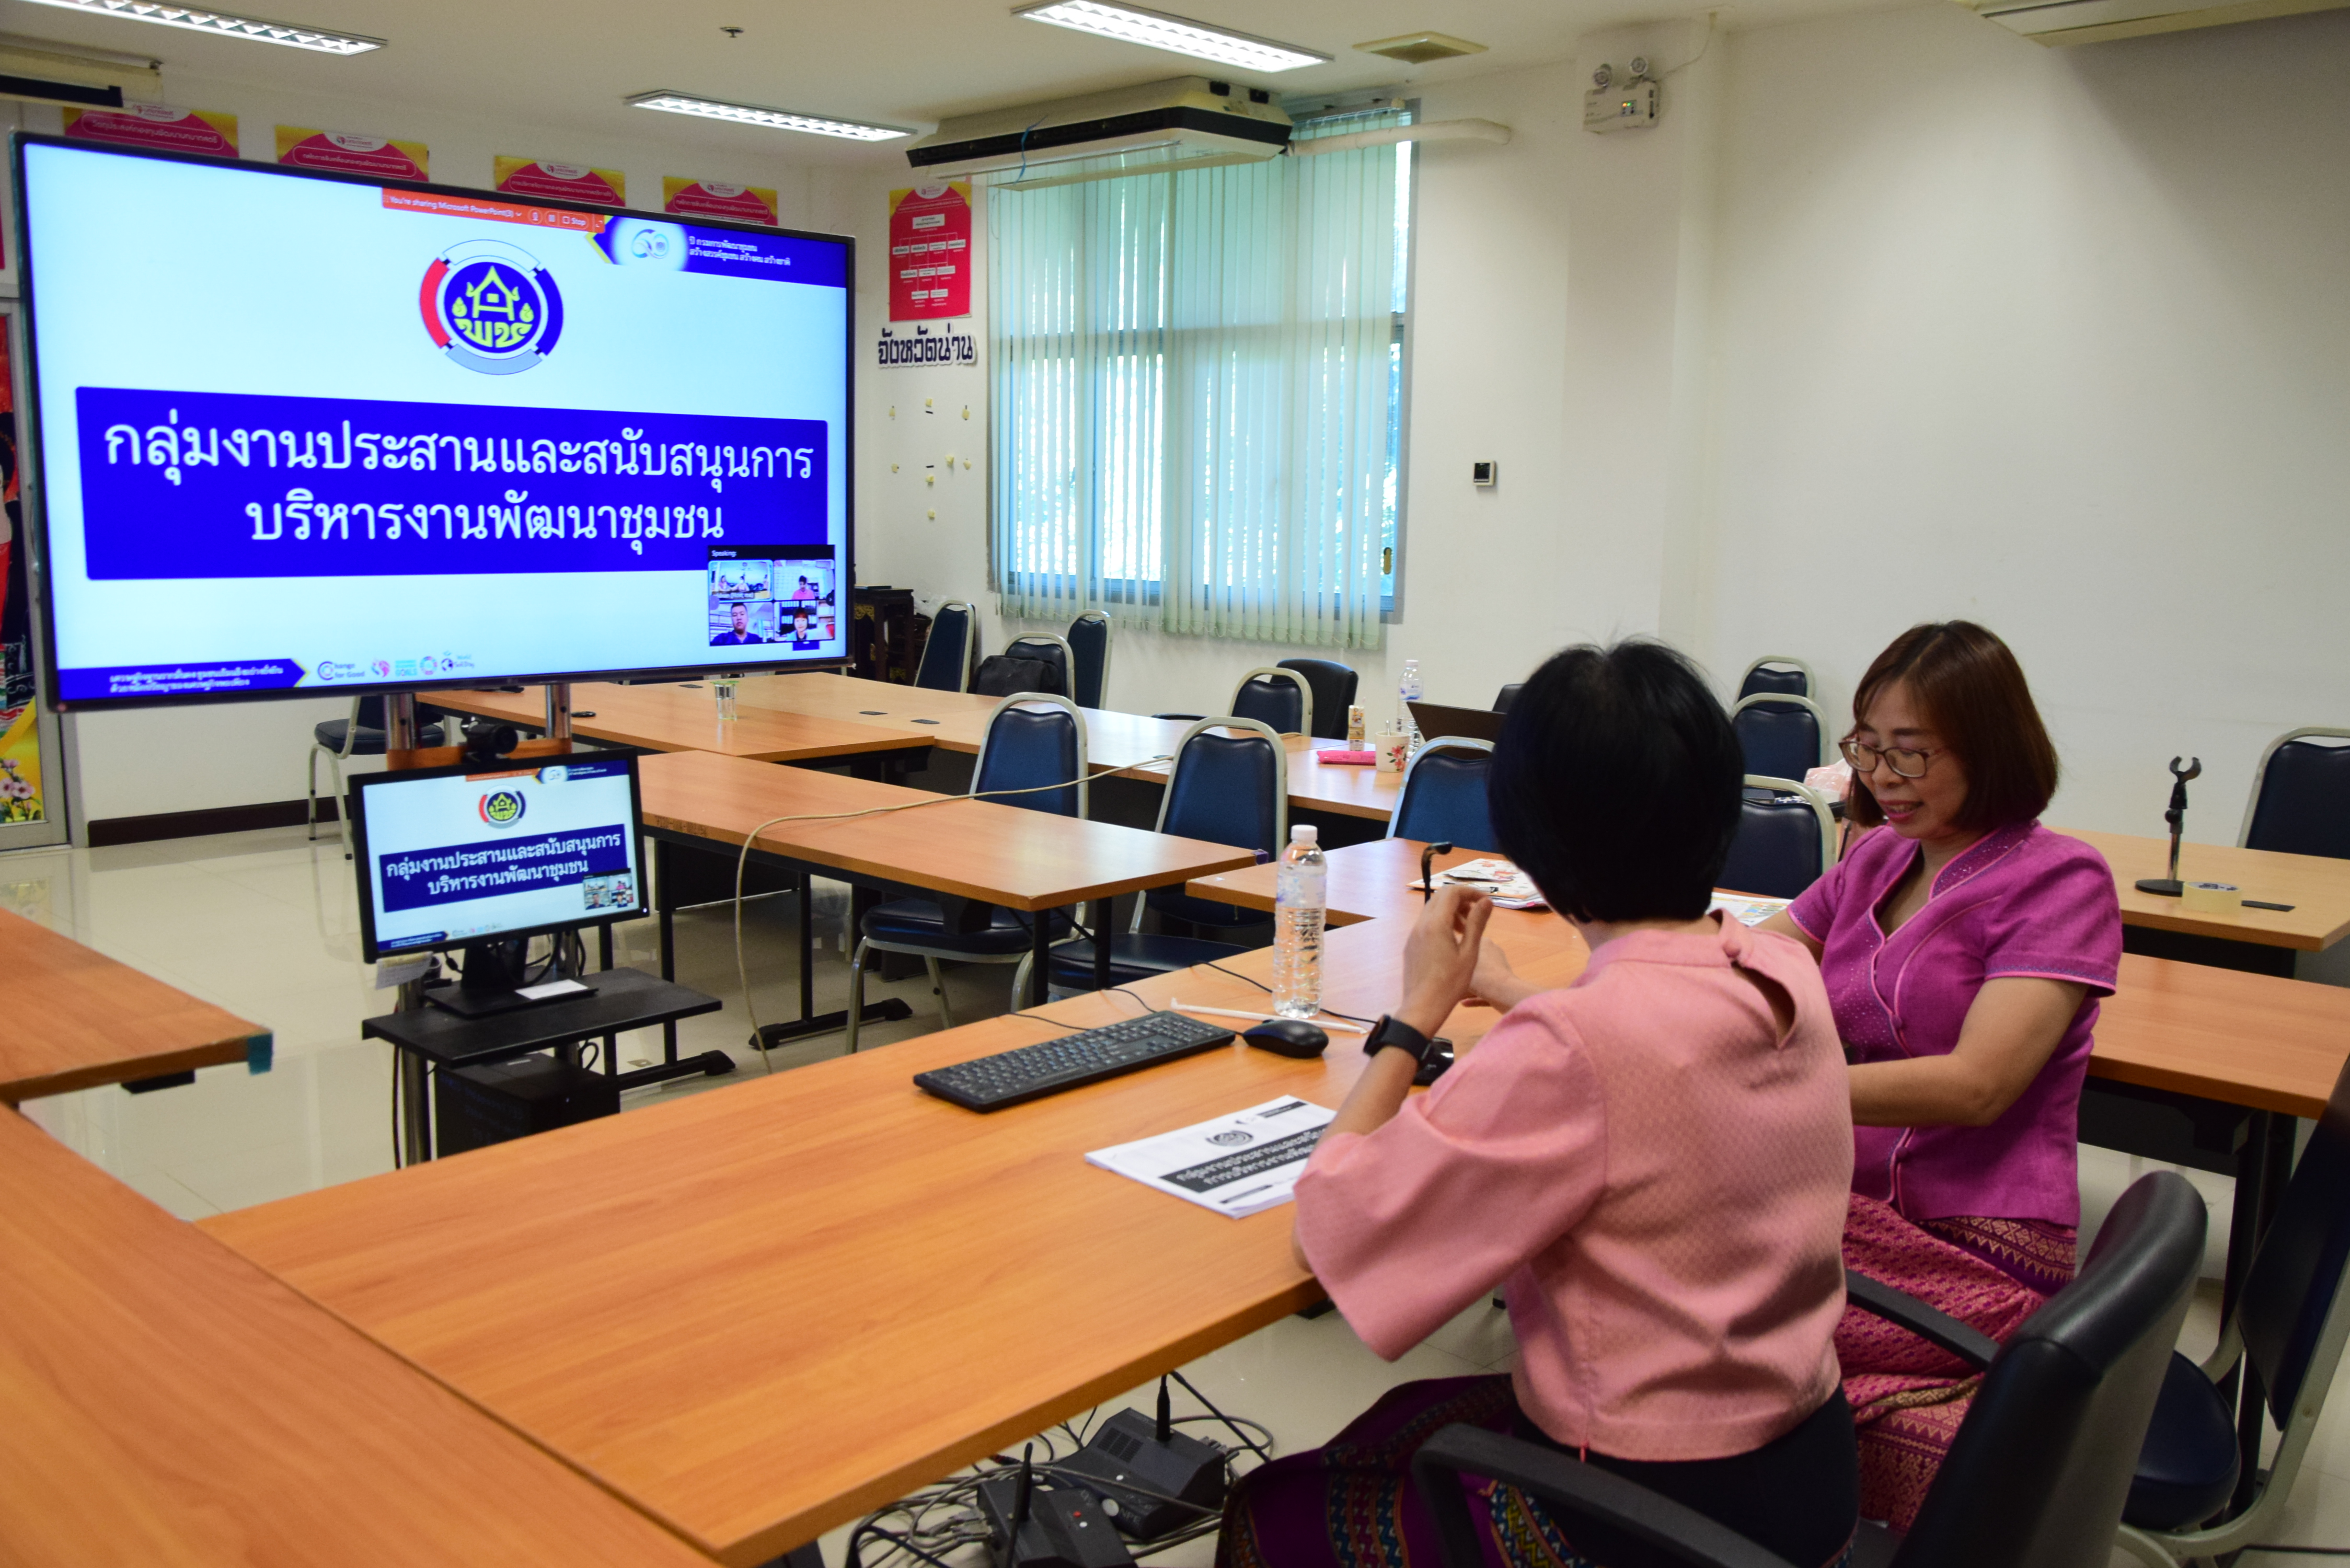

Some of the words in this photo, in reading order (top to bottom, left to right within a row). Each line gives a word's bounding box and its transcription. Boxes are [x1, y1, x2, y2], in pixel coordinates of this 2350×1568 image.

[390, 196, 411, 205] You're
[412, 199, 437, 209] sharing
[438, 201, 469, 211] Microsoft
[571, 217, 586, 226] Stop
[878, 322, 973, 364] จังหวัดน่าน
[105, 408, 814, 493] กลุ่มงานประสานและสนับสนุนการ
[245, 487, 724, 556] บริหารงานพัฒนาชุมชน
[386, 833, 621, 881] กลุ่มงานประสานและสนับสนุนการ
[427, 860, 589, 895] บริหารงานพัฒนาชุมชน
